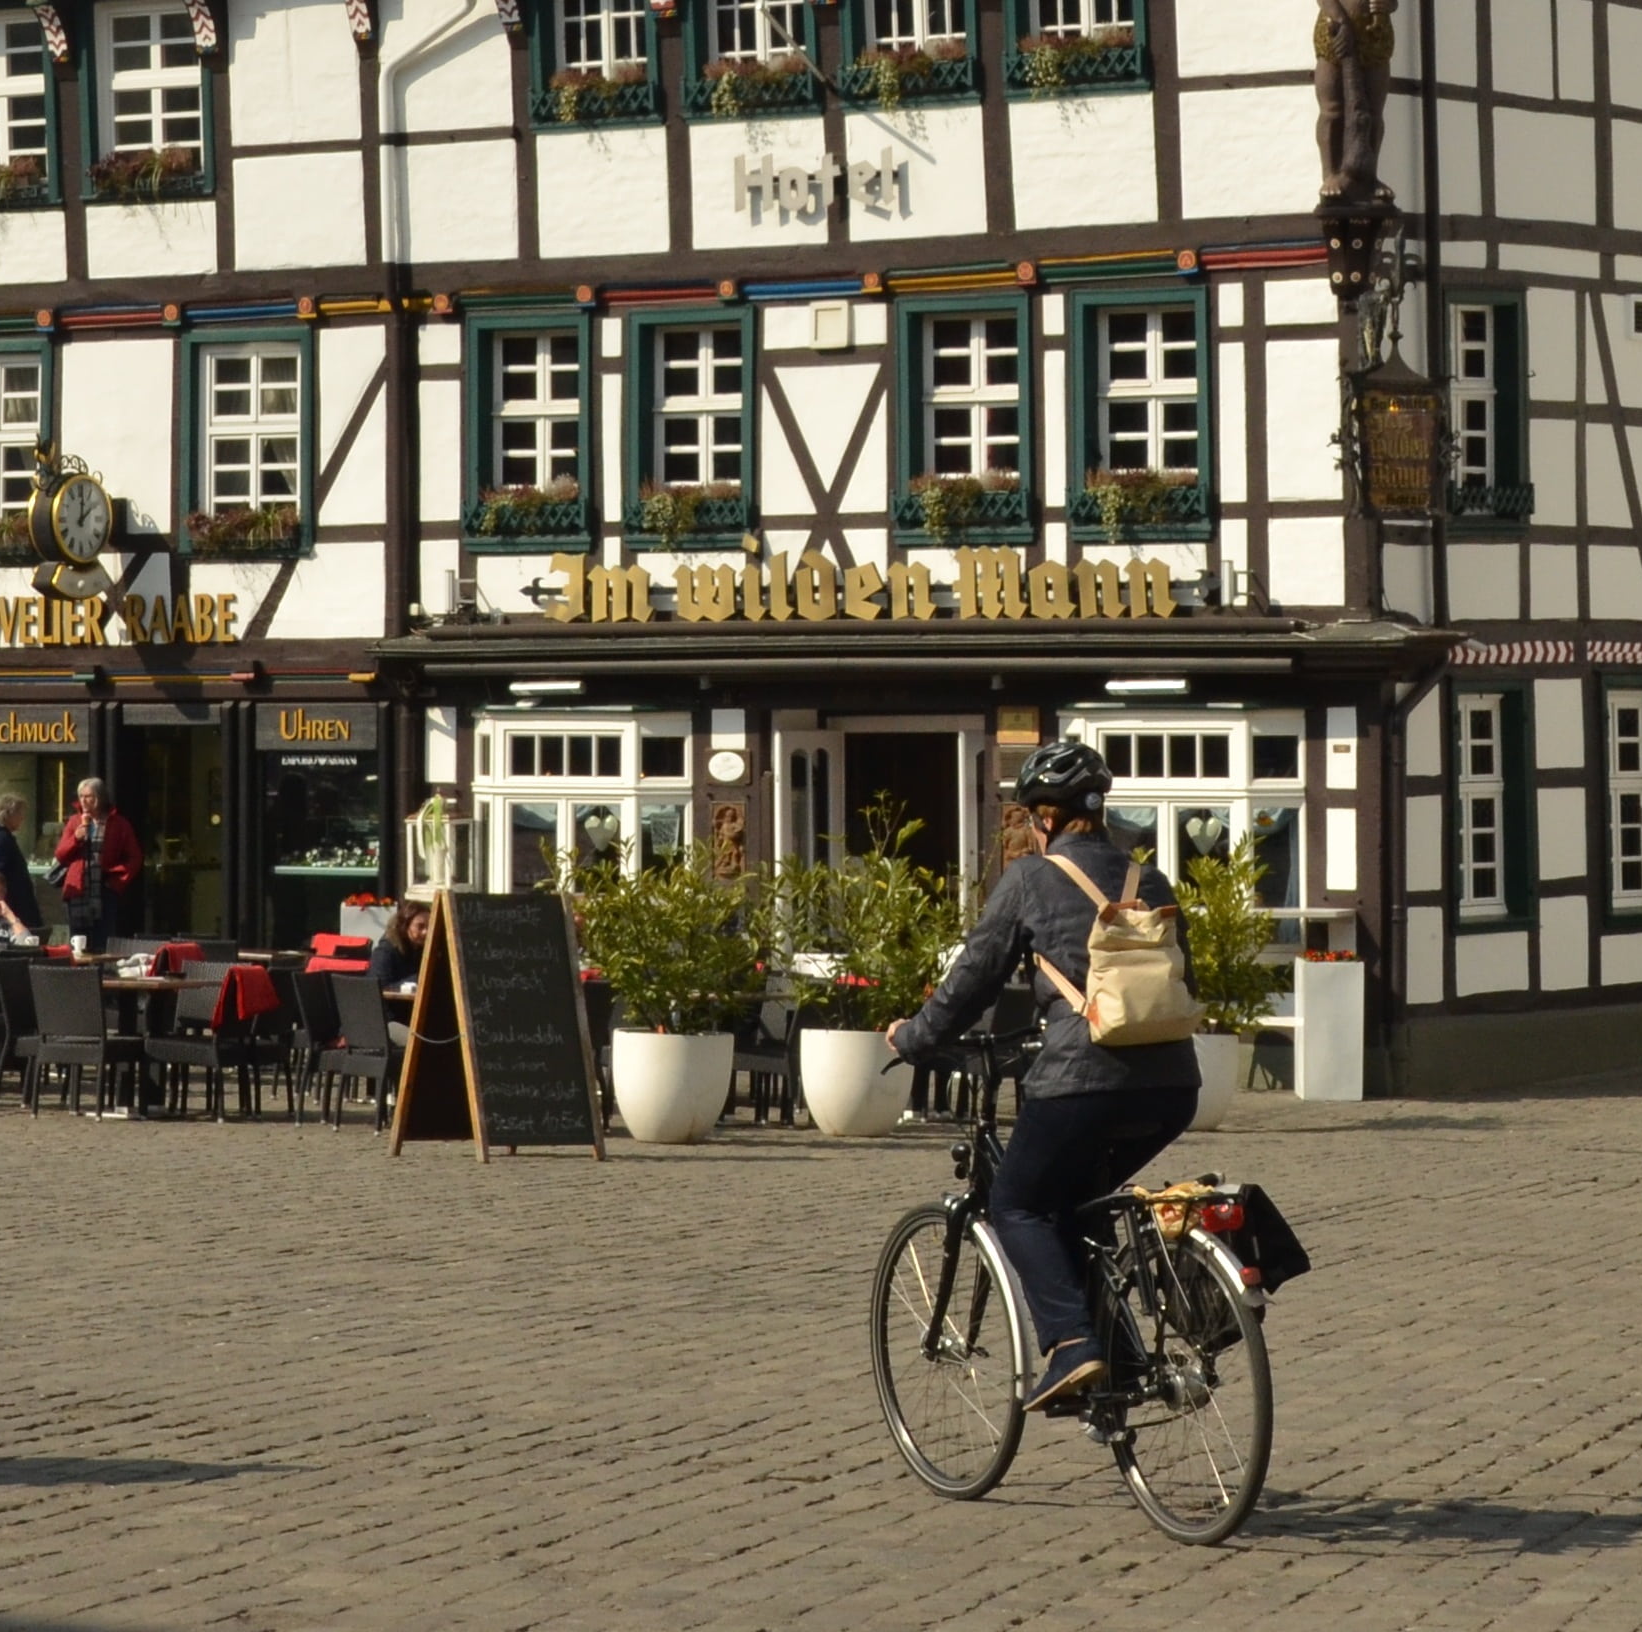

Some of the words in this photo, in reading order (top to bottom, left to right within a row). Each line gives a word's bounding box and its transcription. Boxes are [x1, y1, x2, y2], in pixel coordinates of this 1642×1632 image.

[733, 145, 895, 213] Hotel
[543, 551, 654, 623] Im
[671, 532, 939, 623] wilden
[955, 544, 1177, 621] Mann
[123, 593, 238, 644] RAABE
